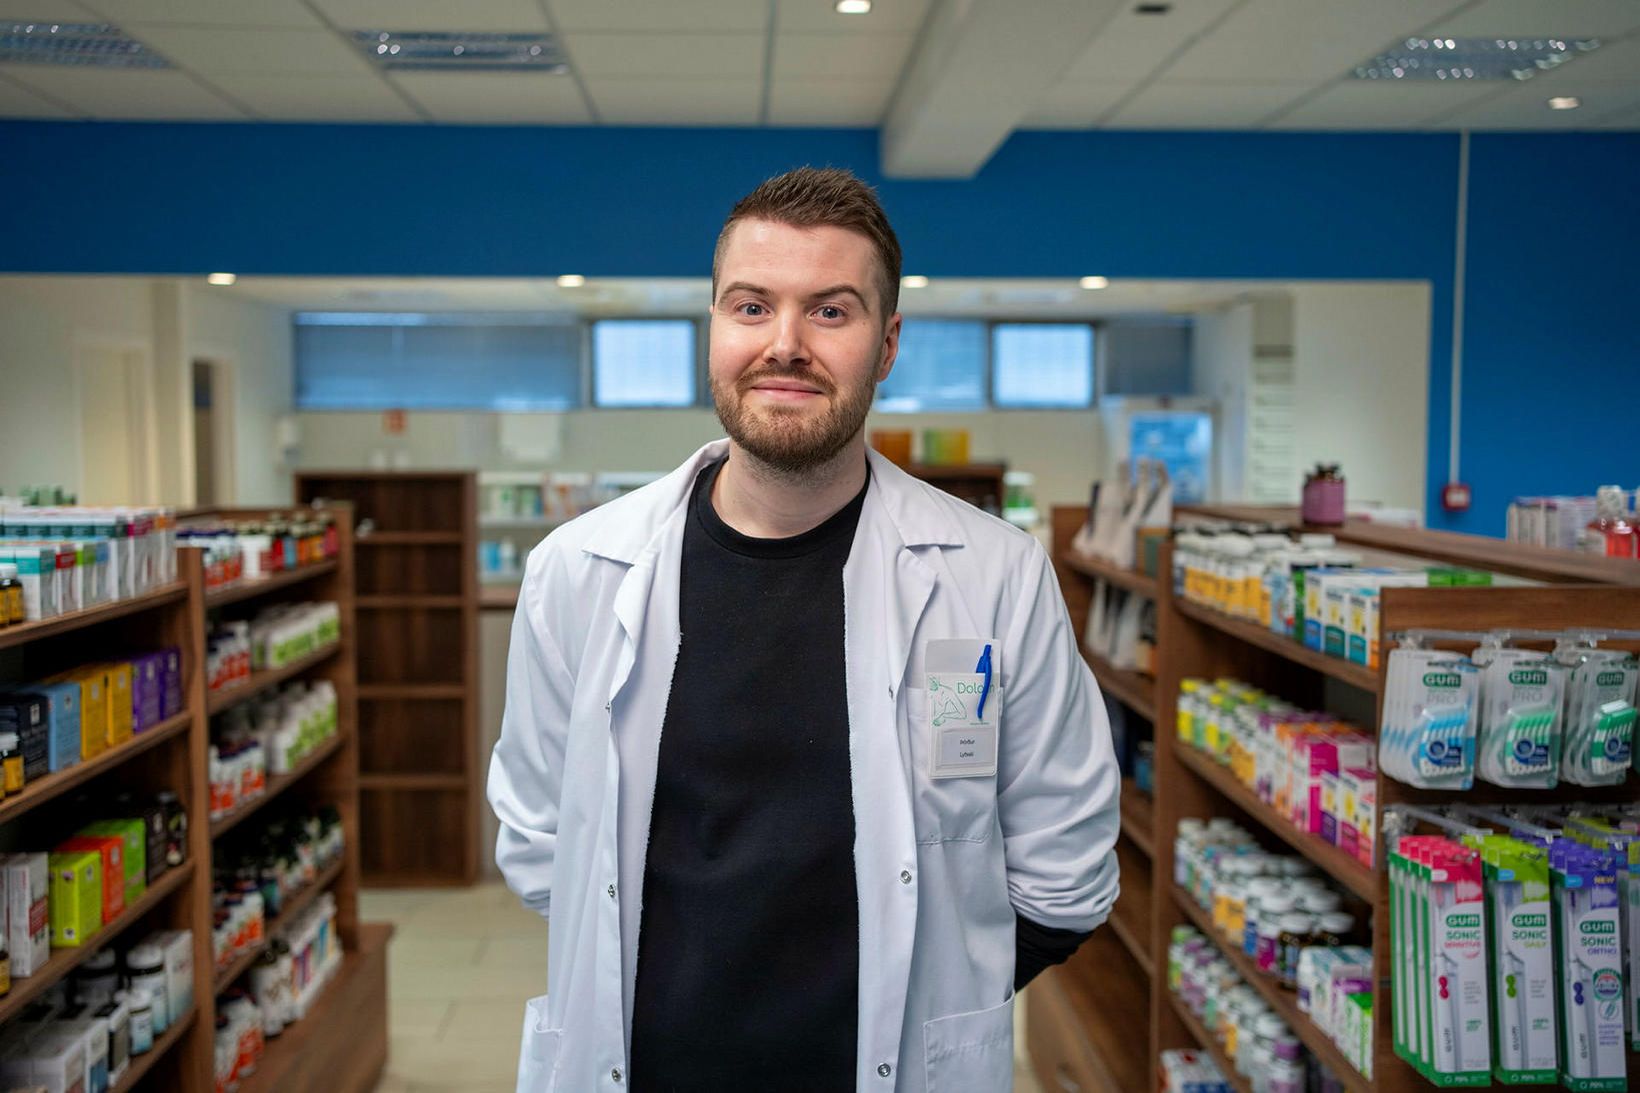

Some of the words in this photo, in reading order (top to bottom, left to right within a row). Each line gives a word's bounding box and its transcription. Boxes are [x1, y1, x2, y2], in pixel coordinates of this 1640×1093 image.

[1423, 674, 1461, 687] GUM
[1509, 671, 1547, 684] GUM
[1593, 876, 1615, 884] NEW
[1447, 915, 1480, 926] GUM
[1513, 915, 1546, 926] GUM
[1581, 922, 1614, 933] GUM
[1446, 931, 1480, 940] SONIC
[1512, 930, 1546, 940] SONIC
[1581, 936, 1616, 946] SONIC
[1587, 947, 1617, 955] ORTHO
